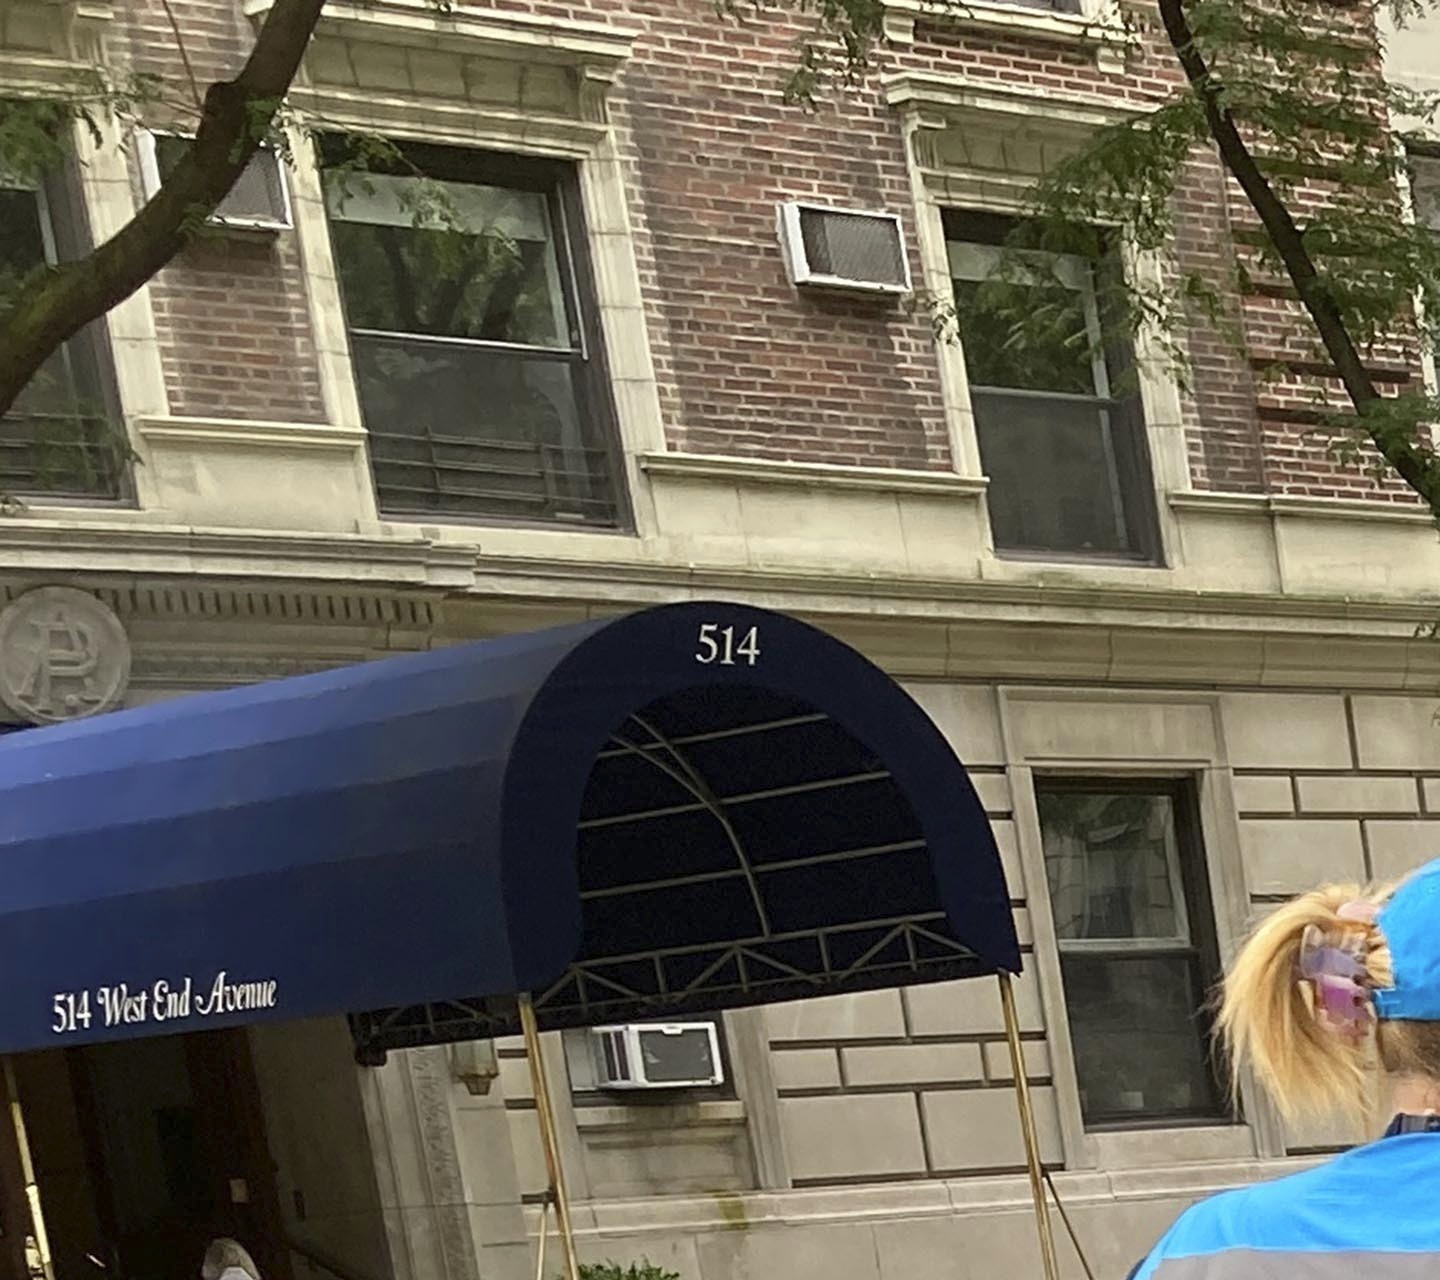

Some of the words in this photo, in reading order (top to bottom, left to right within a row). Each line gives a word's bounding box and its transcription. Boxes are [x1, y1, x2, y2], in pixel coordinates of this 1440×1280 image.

[695, 623, 761, 666] 514
[52, 990, 92, 1033] 514
[97, 982, 149, 1026] West
[152, 977, 192, 1021] End
[194, 970, 278, 1015] Avenue
